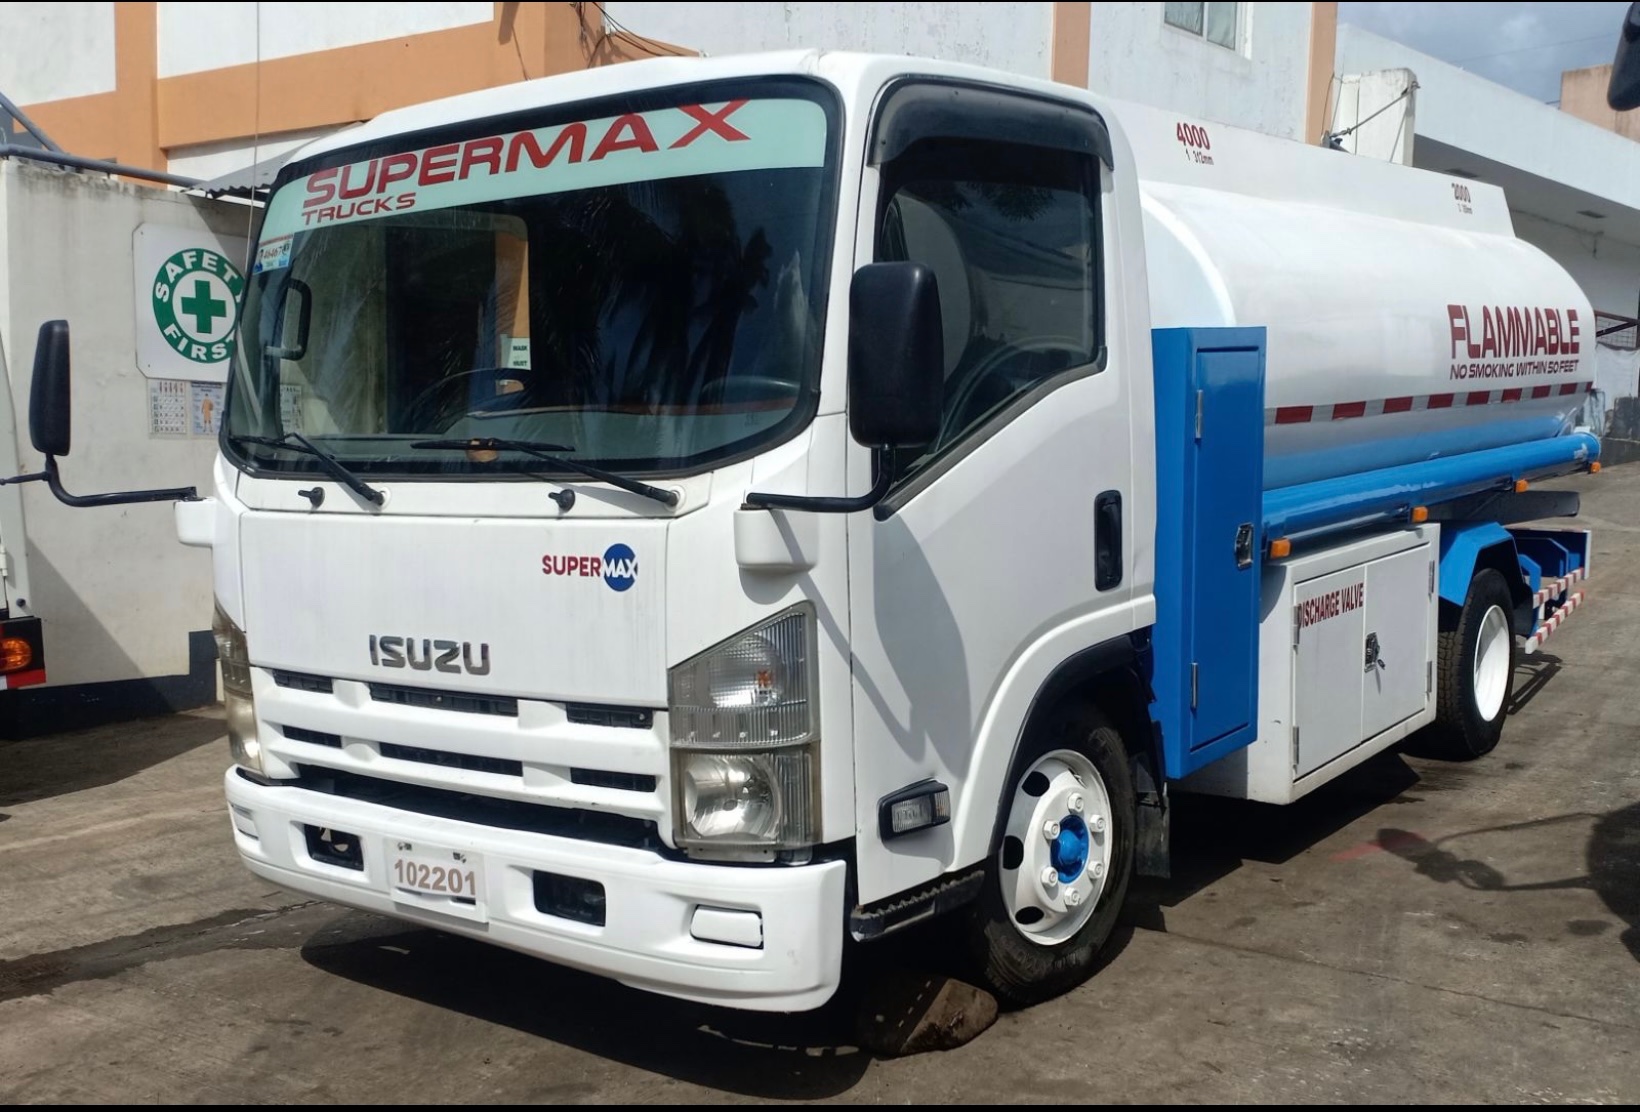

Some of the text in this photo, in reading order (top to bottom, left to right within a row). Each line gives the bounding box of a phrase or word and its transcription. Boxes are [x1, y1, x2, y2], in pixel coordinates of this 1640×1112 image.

[303, 99, 752, 208] SUPERMAX
[1176, 122, 1210, 150] 4000
[301, 192, 417, 226] TRUCKS
[155, 250, 243, 303] SAFET
[1447, 304, 1580, 359] FLAMMABLE
[1449, 364, 1467, 380] NO
[1468, 363, 1514, 379] SMOKING
[1515, 360, 1547, 376] WITHIN
[1559, 359, 1580, 373] FEET
[1297, 582, 1364, 629] DISCHARGE VALVE
[368, 634, 491, 676] ISUZU
[394, 858, 476, 896] 102201
